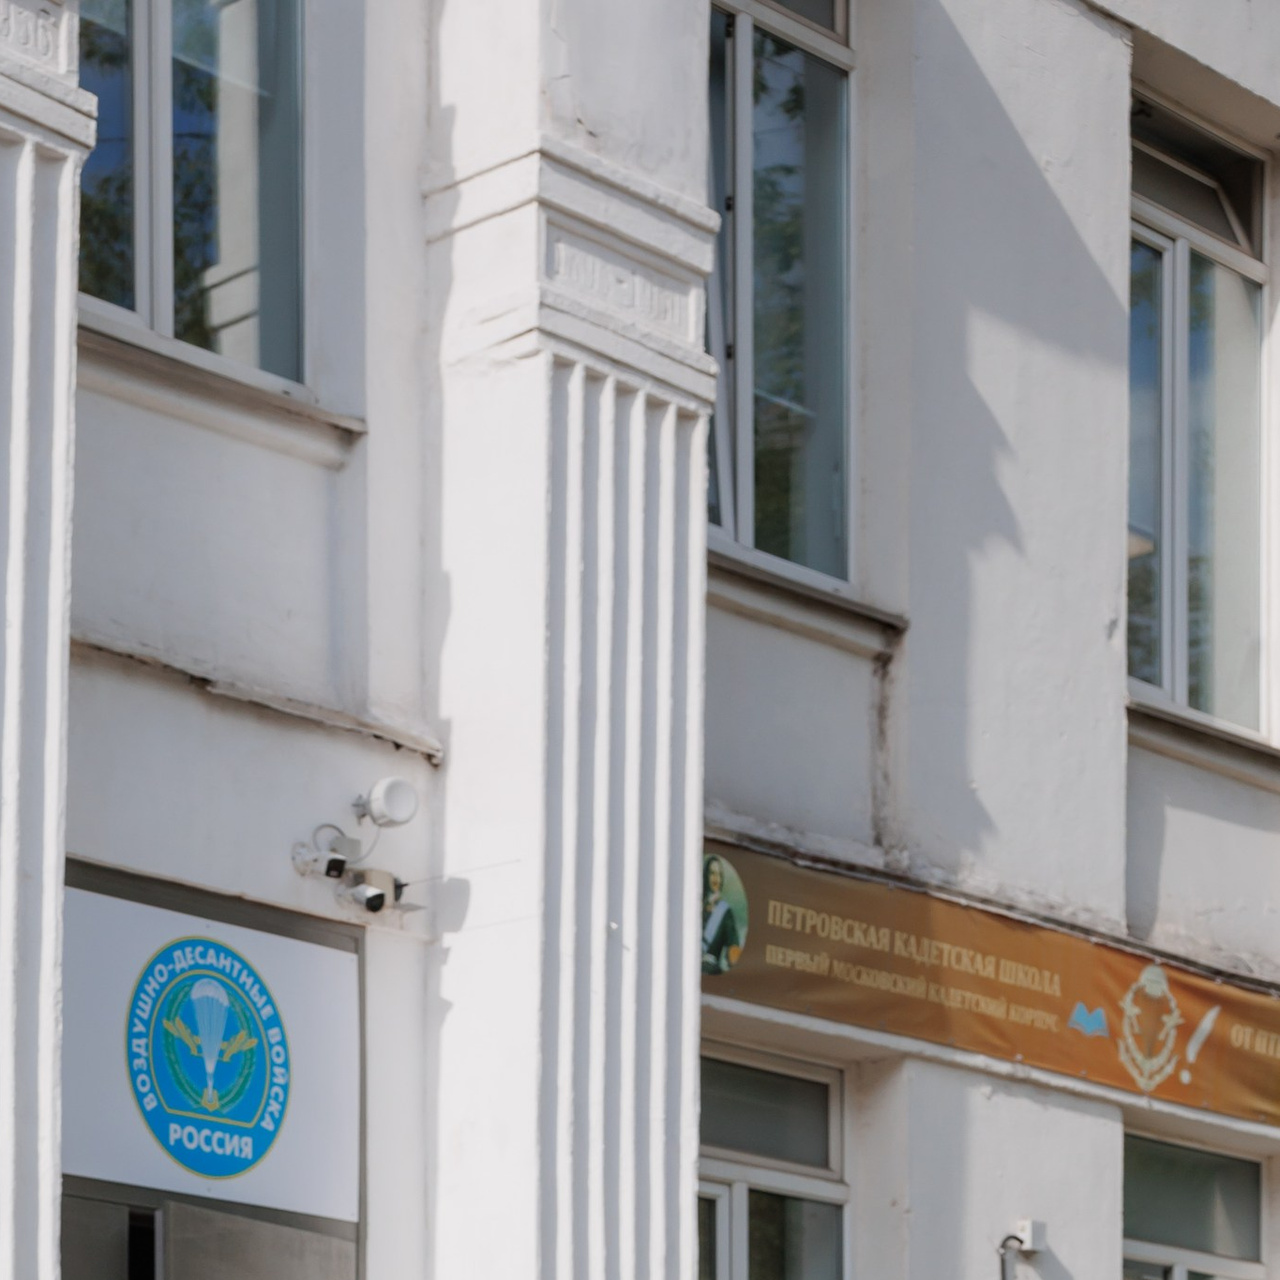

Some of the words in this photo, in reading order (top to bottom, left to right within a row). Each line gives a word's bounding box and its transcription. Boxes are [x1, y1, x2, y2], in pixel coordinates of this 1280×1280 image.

[766, 944, 831, 976] ПЕРВЫЙ
[768, 900, 890, 952] ПЕТРОВСКАЯ
[893, 930, 997, 980] КАДЕТСКАЯ
[999, 957, 1062, 998] ШКОЛА
[131, 945, 275, 1112] ВОЗДУШНО-ДЕСАНТНЫЕ
[259, 1026, 289, 1132] ВОЙСКА
[169, 1122, 254, 1160] РОССИЯ
